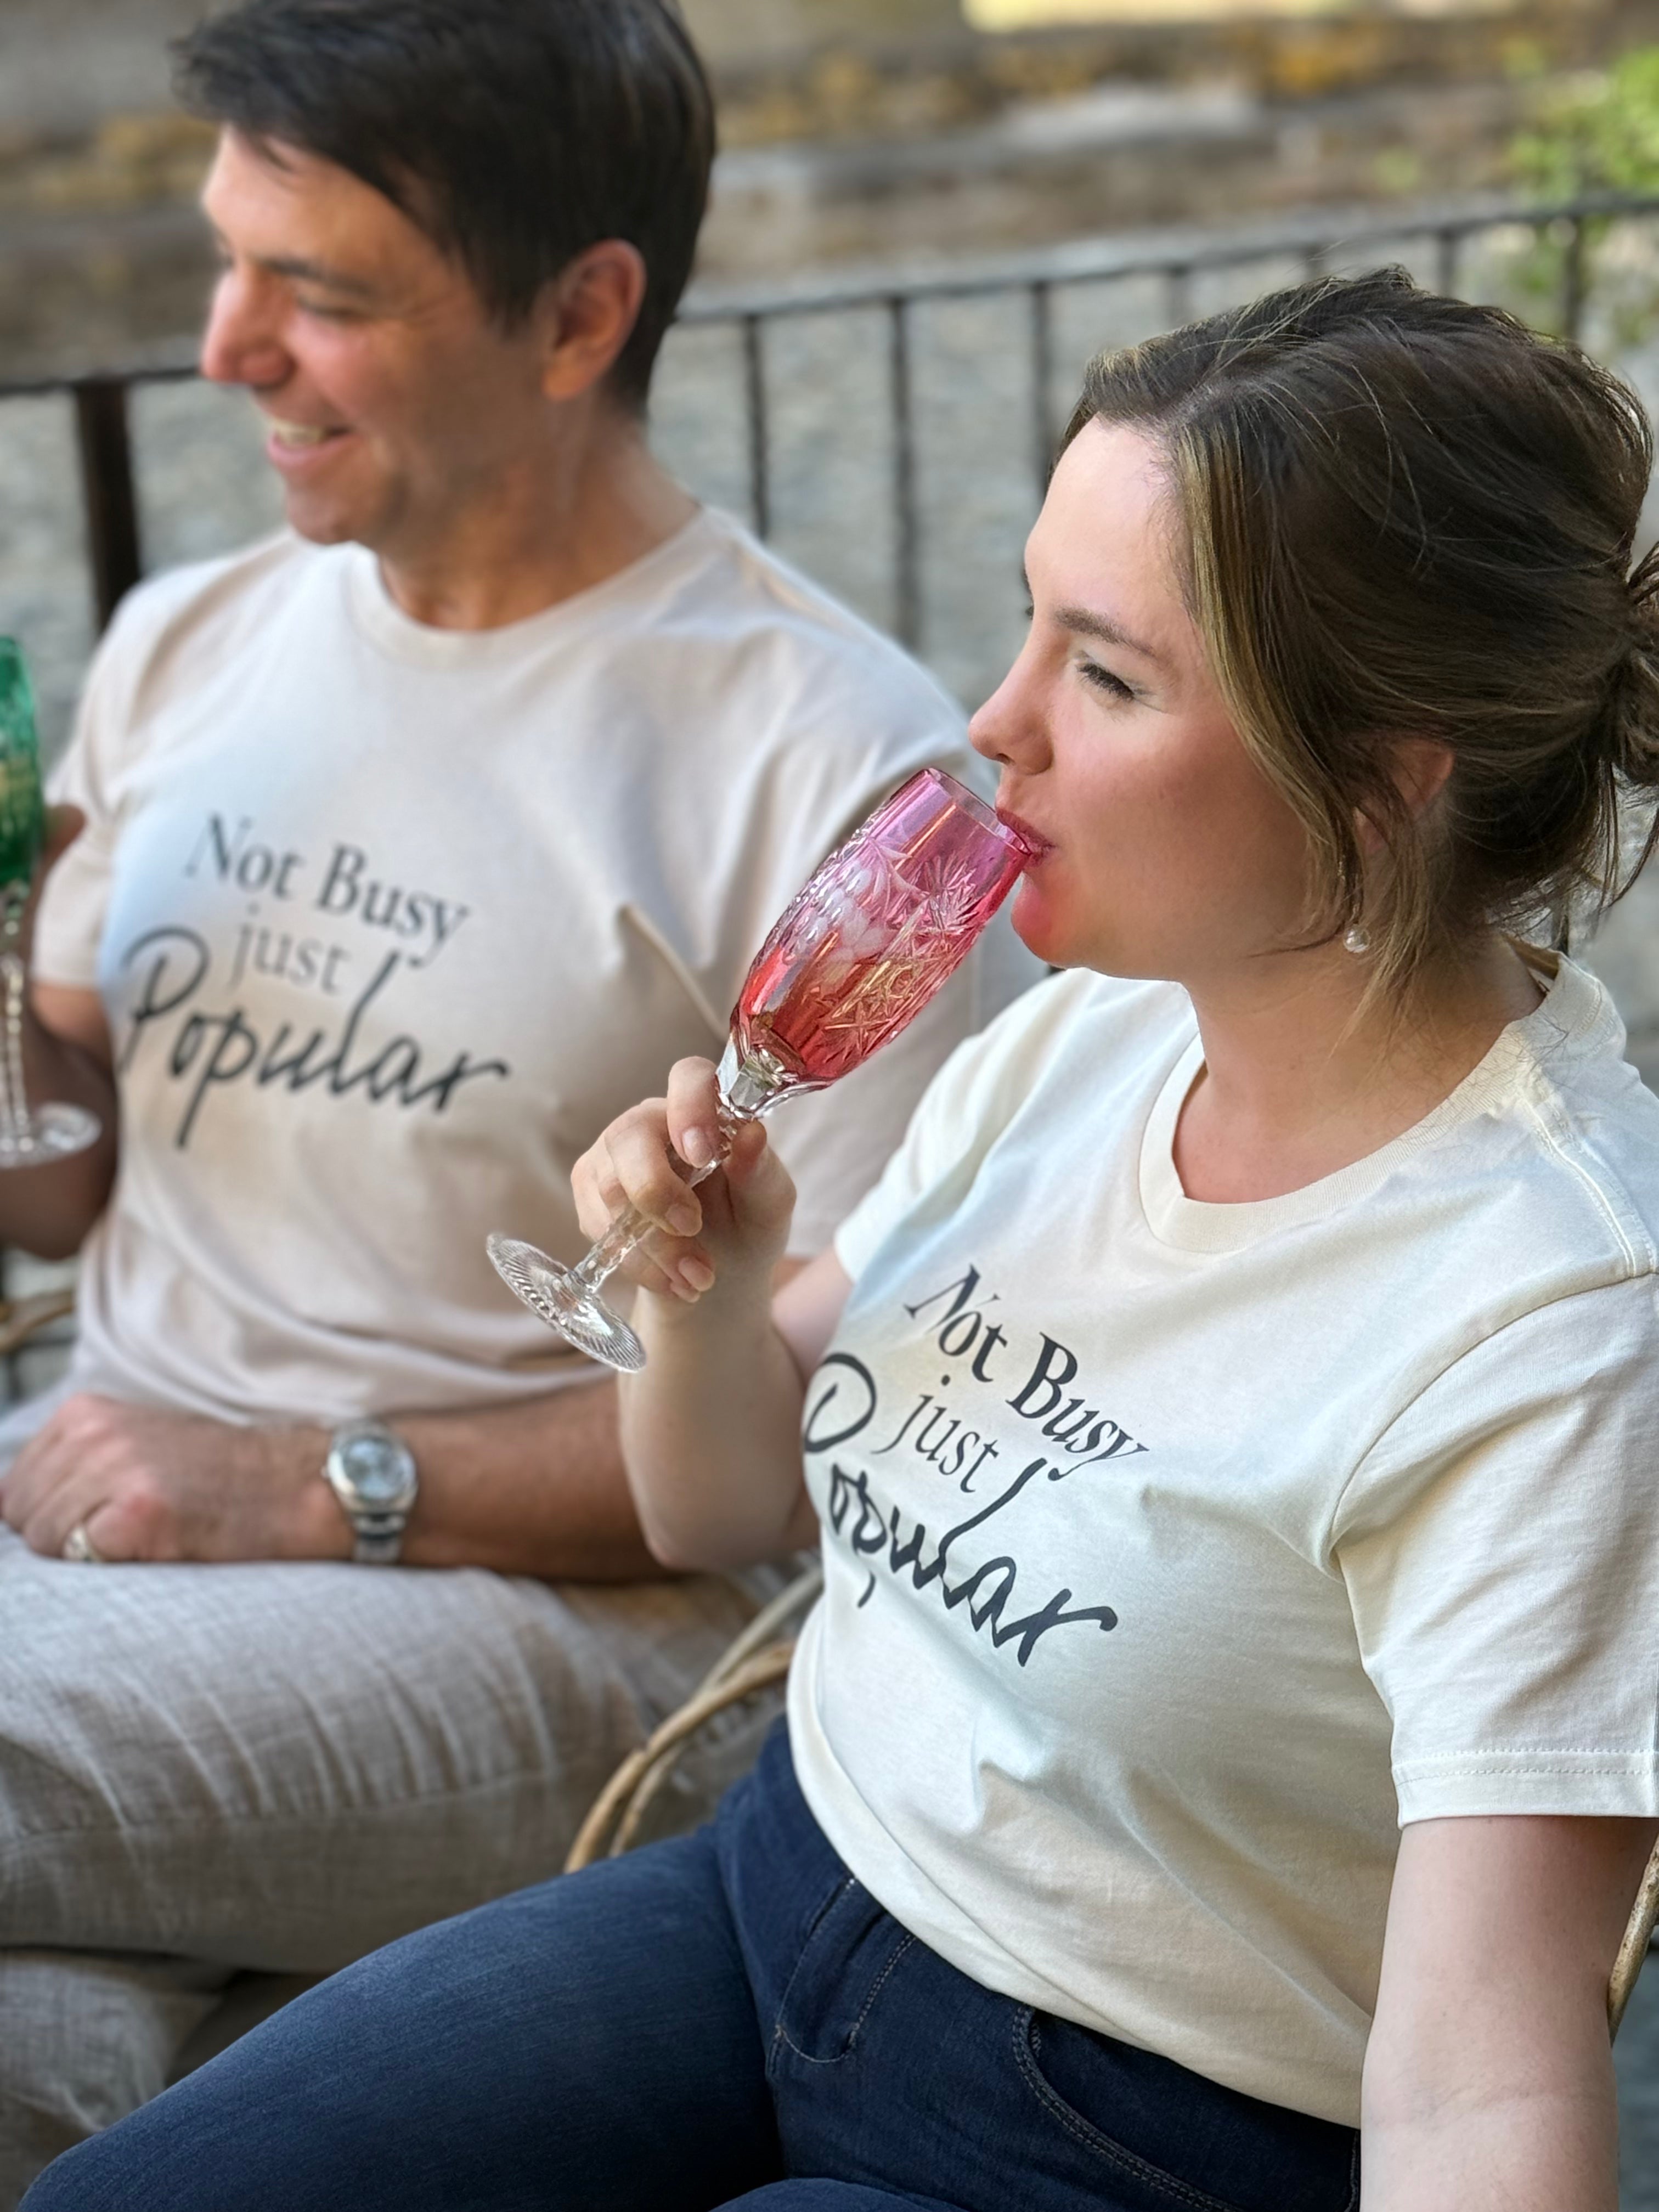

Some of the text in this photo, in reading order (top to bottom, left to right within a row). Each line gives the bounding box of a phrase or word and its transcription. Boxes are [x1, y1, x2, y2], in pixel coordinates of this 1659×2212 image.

[184, 814, 473, 968] Not Busy
[226, 901, 352, 994] just
[119, 924, 510, 1150] Popular
[871, 1374, 1000, 1493] just
[902, 1263, 1150, 1481] Not Busy
